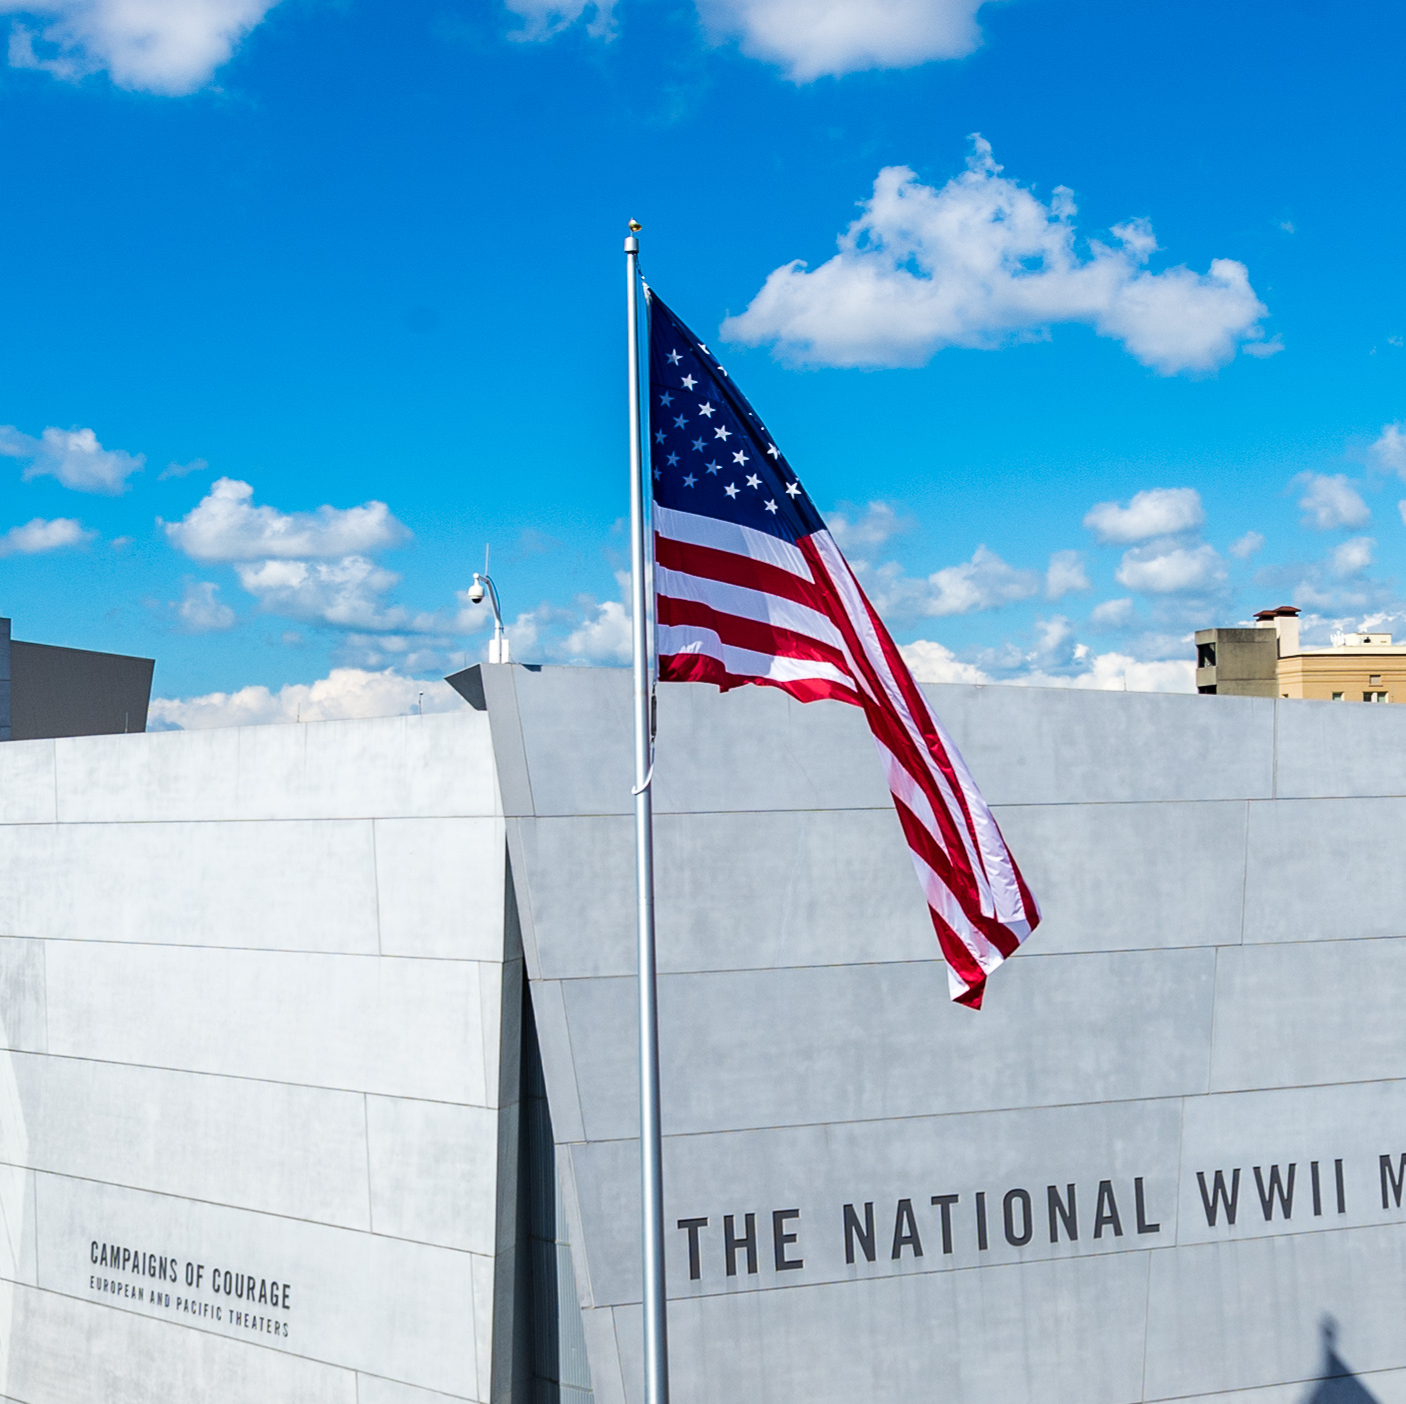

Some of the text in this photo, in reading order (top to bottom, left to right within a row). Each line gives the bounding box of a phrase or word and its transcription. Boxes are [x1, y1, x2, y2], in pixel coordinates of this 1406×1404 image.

[676, 1208, 804, 1281] THE
[842, 1176, 1161, 1265] NATIONAL
[1195, 1158, 1346, 1227] WWII
[90, 1240, 291, 1310] CAMPAIGNS OF COURAGE
[90, 1275, 289, 1338] EUROPEAN AND PACIFIC THEATERS
